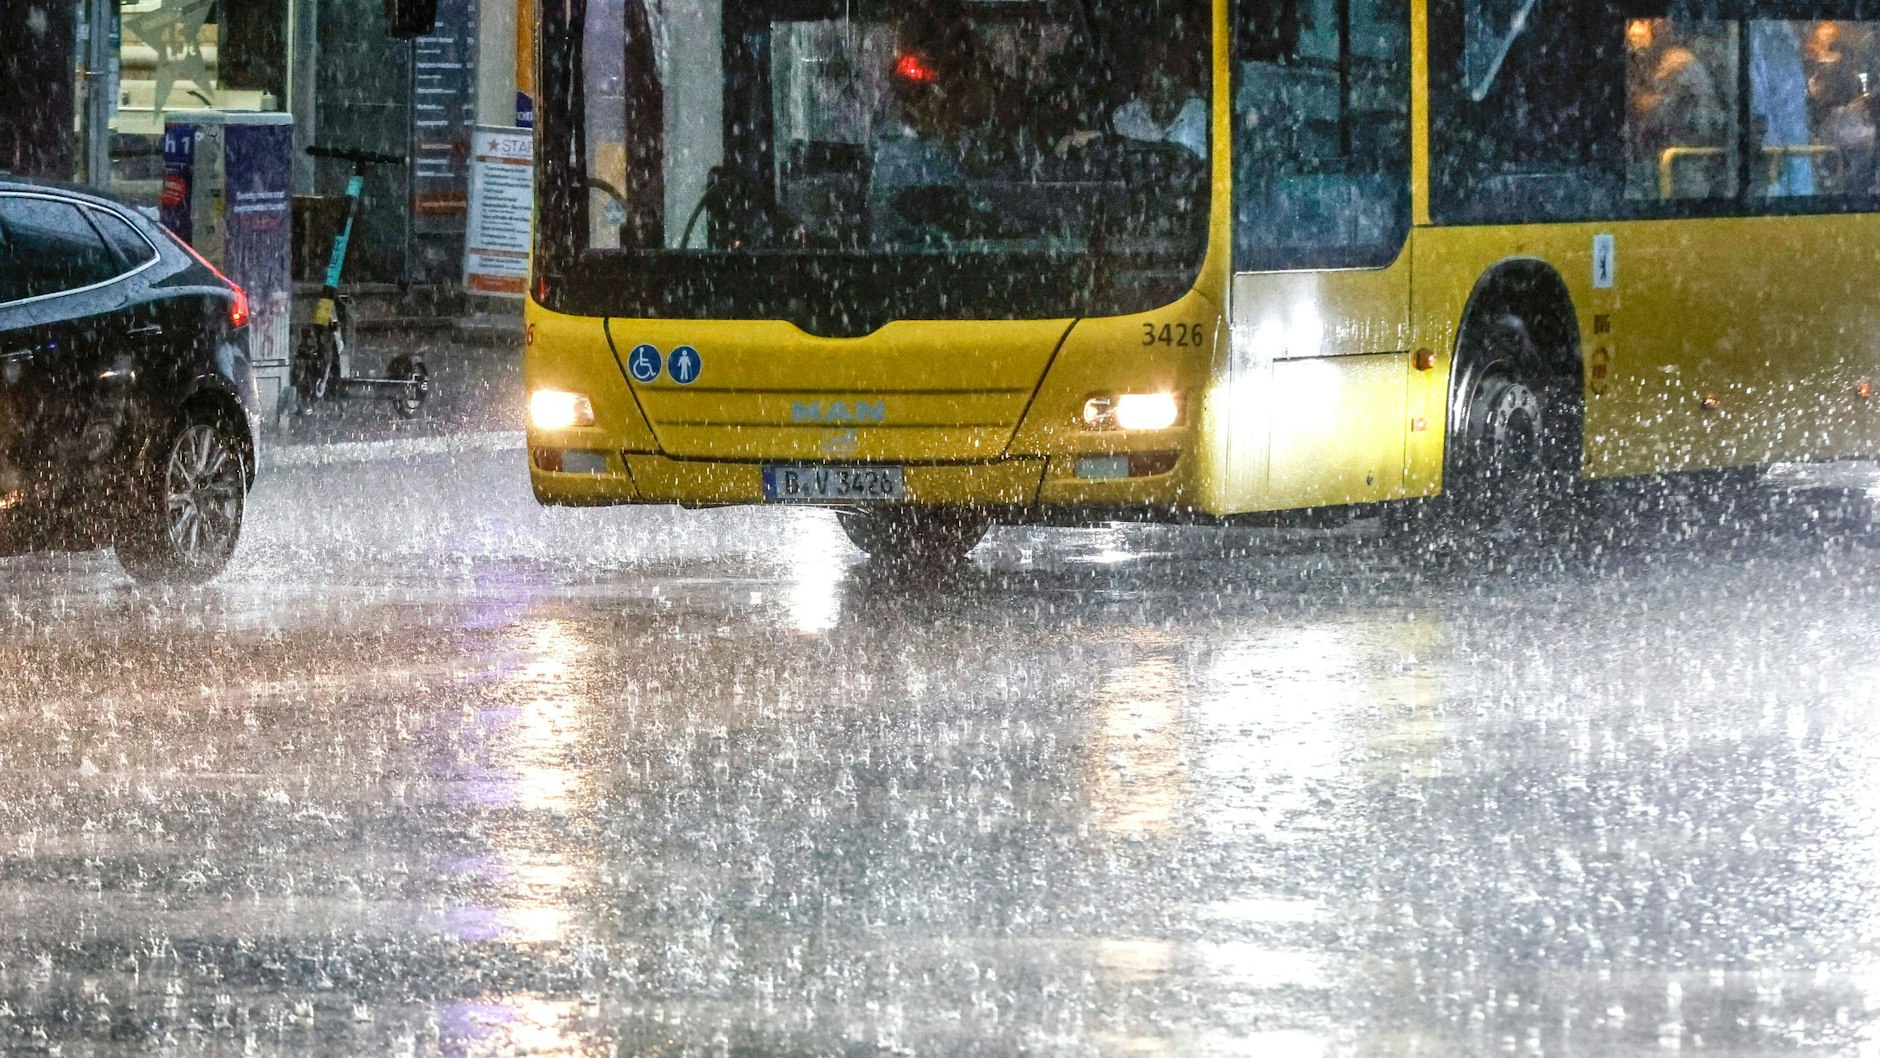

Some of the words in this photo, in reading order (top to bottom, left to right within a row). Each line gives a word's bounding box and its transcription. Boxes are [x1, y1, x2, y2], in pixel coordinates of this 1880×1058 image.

[1142, 322, 1203, 347] 3426
[791, 401, 884, 421] MAN
[837, 470, 893, 495] 3426
